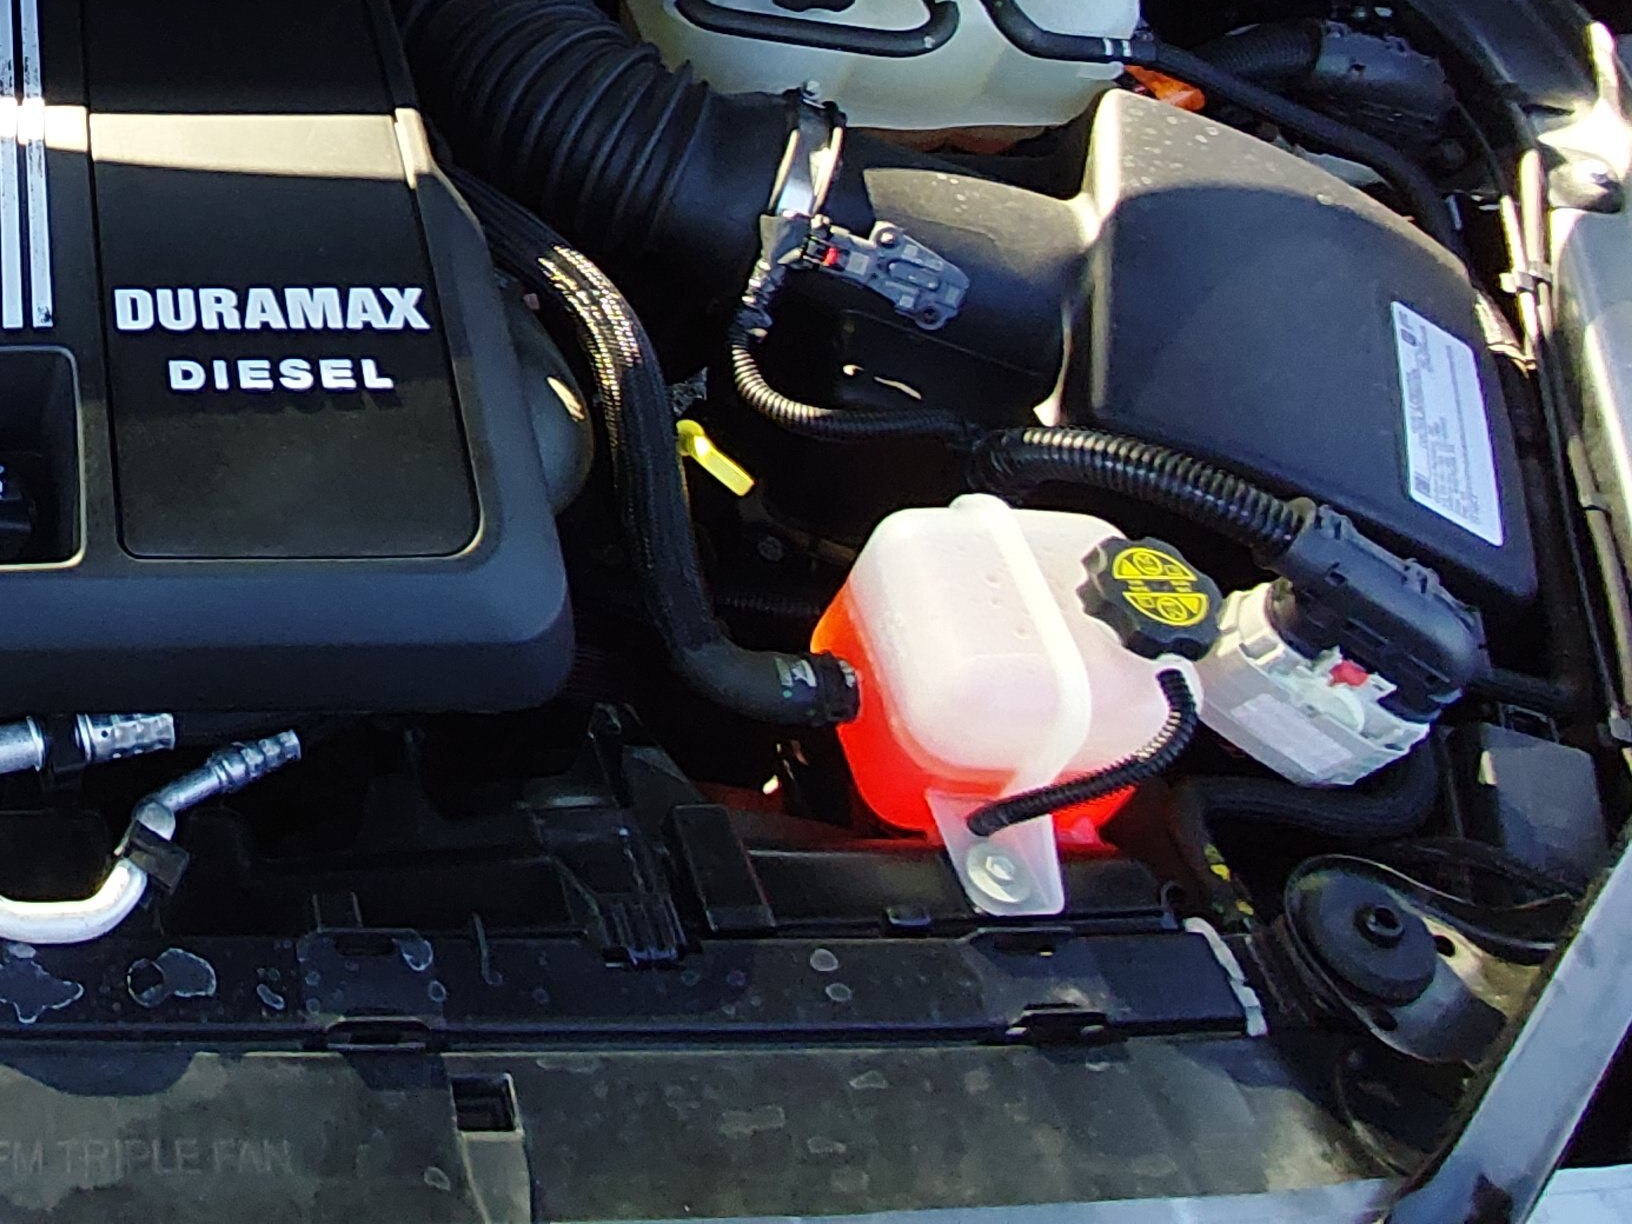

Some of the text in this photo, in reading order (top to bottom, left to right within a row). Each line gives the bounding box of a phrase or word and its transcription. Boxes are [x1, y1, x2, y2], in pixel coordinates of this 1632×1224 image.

[114, 287, 430, 332] DURAMAX
[169, 358, 394, 392] DIESEL
[58, 1137, 202, 1177] TRIPLE
[212, 1137, 294, 1176] FAN
